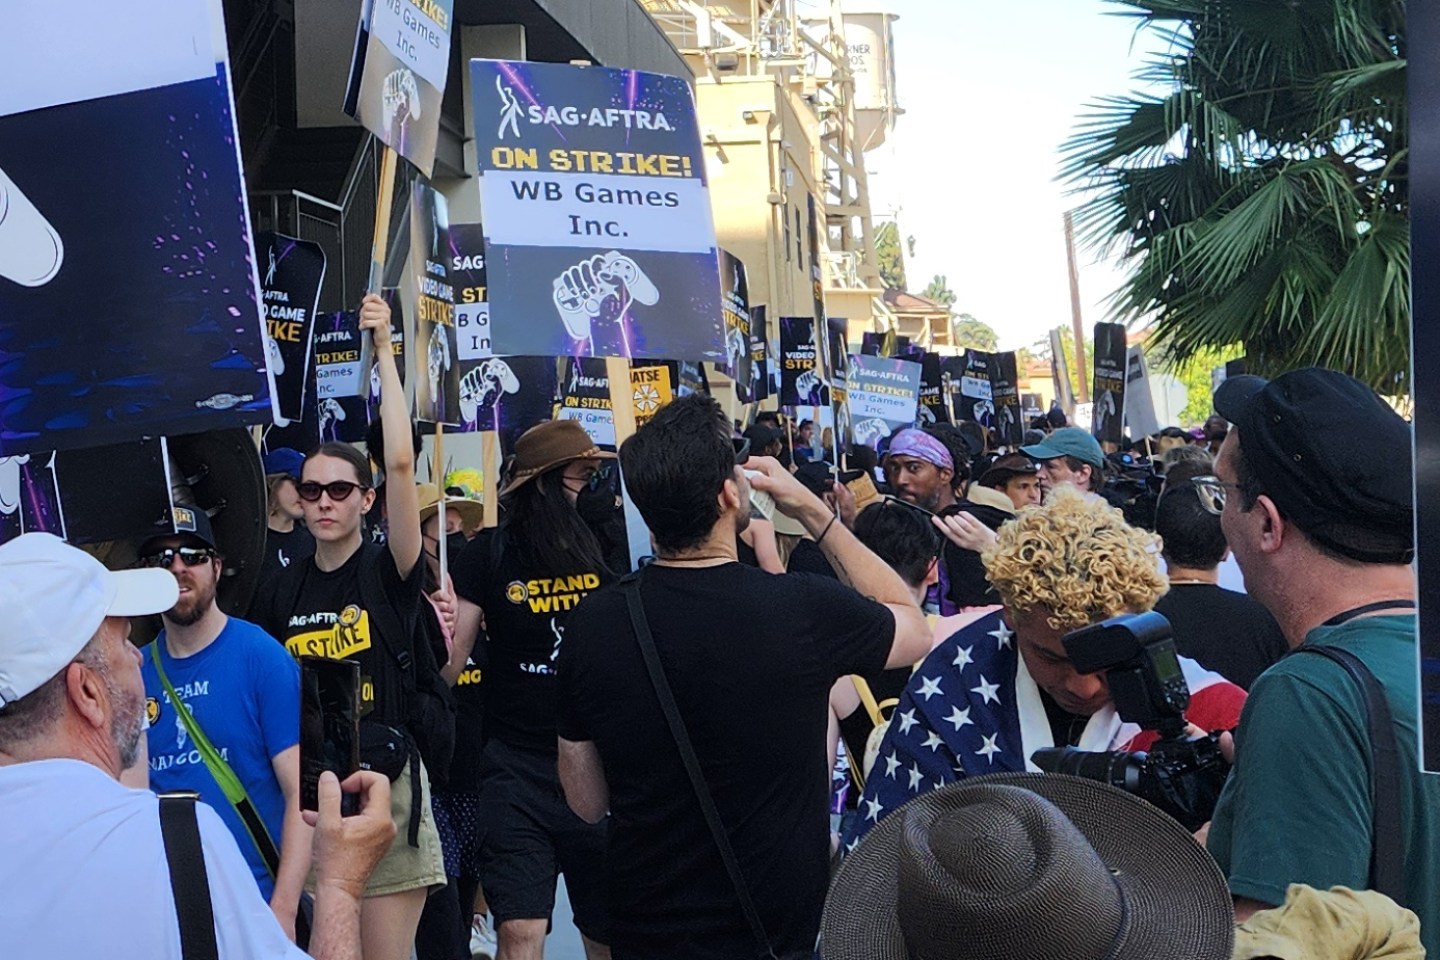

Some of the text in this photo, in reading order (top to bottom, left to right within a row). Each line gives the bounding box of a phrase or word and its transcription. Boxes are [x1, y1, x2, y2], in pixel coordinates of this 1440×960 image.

[403, 9, 441, 50] Games
[491, 147, 693, 178] ON STRIKE!
[511, 180, 679, 208] WB Games
[568, 214, 629, 237] Inc.
[270, 304, 306, 322] GAME
[418, 295, 454, 328] STRIKE
[785, 351, 815, 359] VIDEO
[869, 395, 905, 407] Games
[585, 413, 615, 425] Game
[527, 573, 600, 596] STAND
